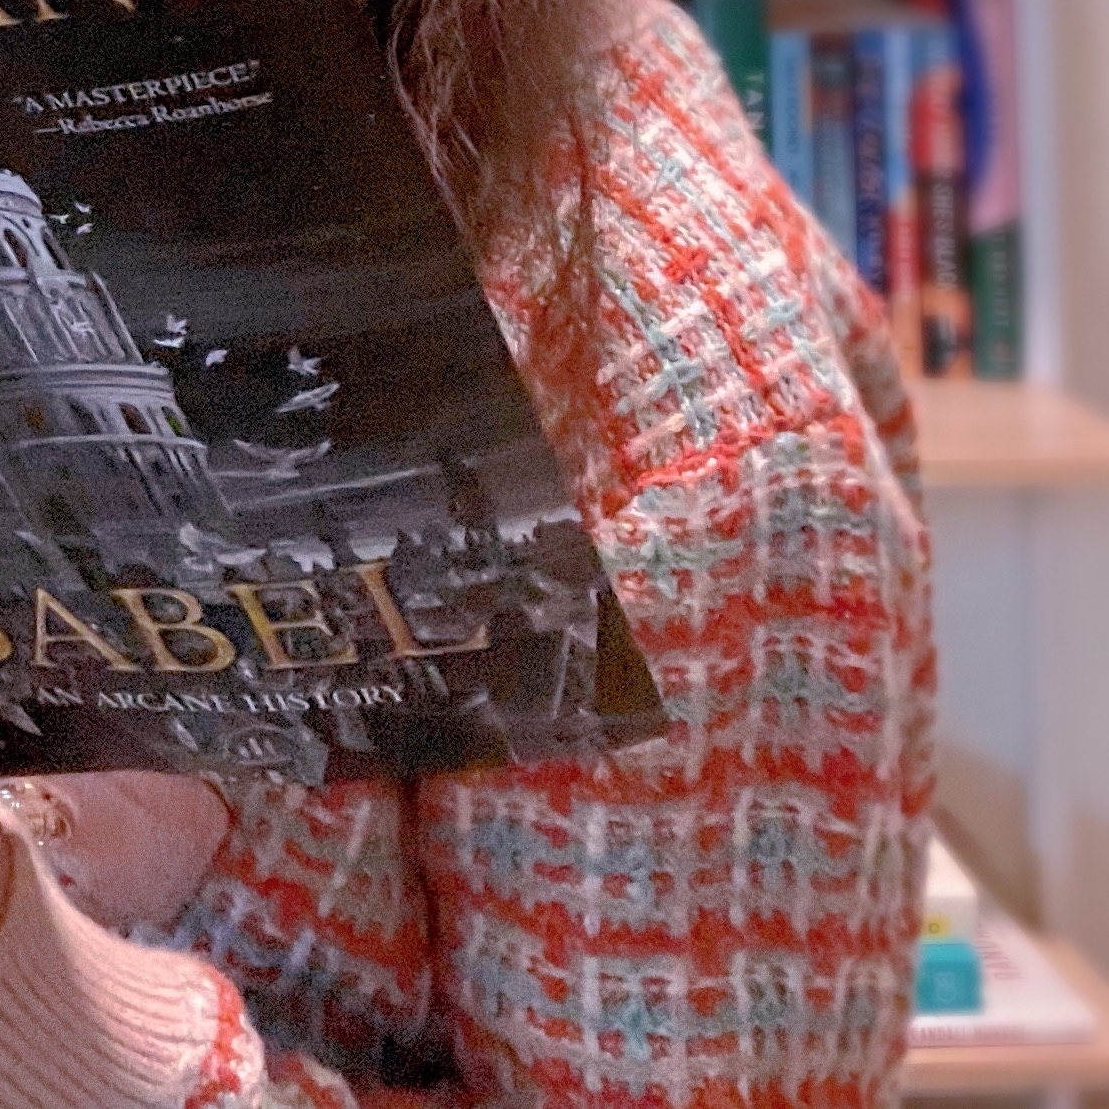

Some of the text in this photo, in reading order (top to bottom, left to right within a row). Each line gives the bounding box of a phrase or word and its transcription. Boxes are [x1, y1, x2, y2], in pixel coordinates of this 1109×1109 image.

[933, 236, 957, 293] BLACK
[97, 689, 227, 713] ARCANE
[241, 683, 404, 713] HISTORY
